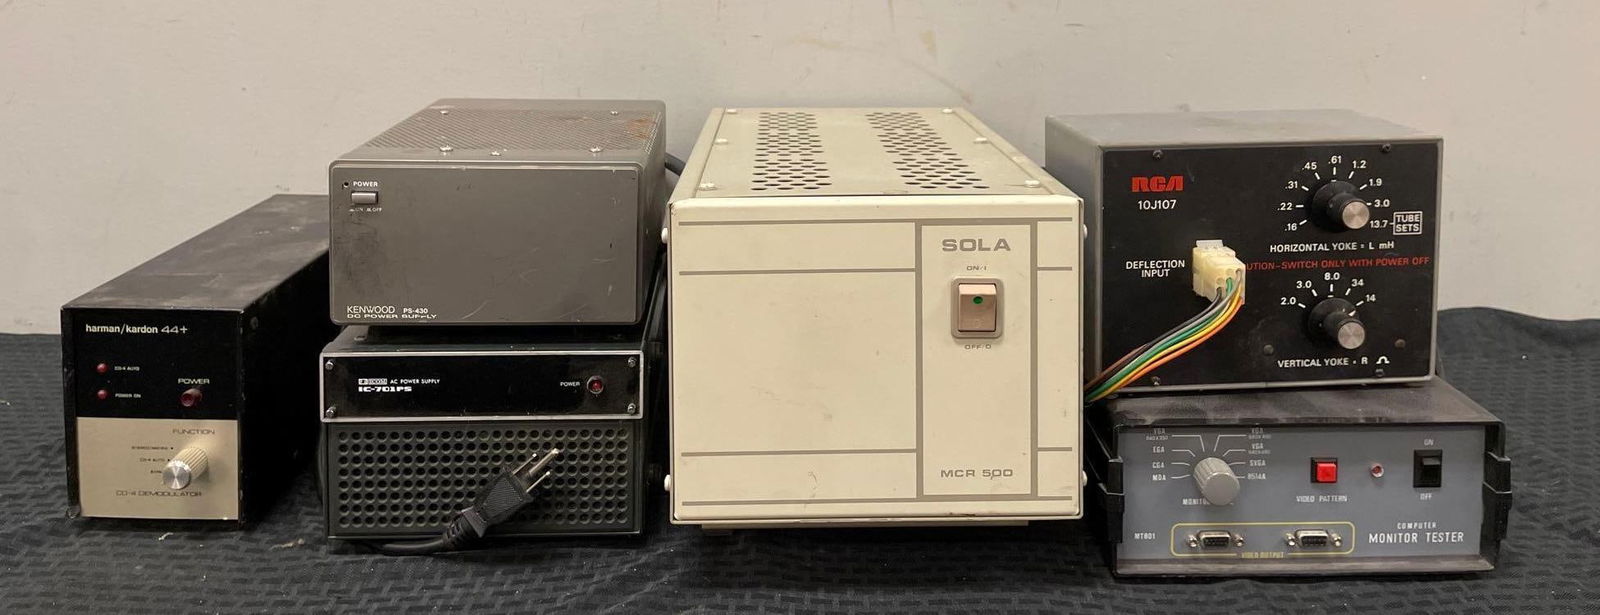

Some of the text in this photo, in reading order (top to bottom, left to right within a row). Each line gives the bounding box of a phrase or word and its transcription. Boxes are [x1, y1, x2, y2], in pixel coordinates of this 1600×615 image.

[1328, 155, 1342, 164] .61
[1302, 162, 1318, 171] .45
[1352, 160, 1367, 169] 1.2
[1131, 175, 1184, 193] RCA
[1285, 181, 1298, 189] .31
[1369, 178, 1382, 187] 1.9
[1137, 199, 1177, 211] 10J107
[1277, 203, 1293, 211] .22
[1374, 199, 1390, 208] 3.0
[1395, 214, 1420, 223] TUBE
[1284, 222, 1298, 231] .16
[1370, 219, 1388, 229] 13.7
[1395, 223, 1420, 232] SETS
[941, 238, 1012, 252] SOLA
[1270, 243, 1330, 253] HORIZONTAL
[1331, 242, 1358, 251] YOKE
[1368, 242, 1375, 250] L
[1379, 241, 1395, 250] mH
[1125, 259, 1186, 270] DEFLECTION
[1321, 259, 1345, 269] ONLY
[1349, 258, 1373, 267] WITH
[1375, 257, 1408, 267] POWER
[1412, 256, 1431, 265] OFF
[1141, 269, 1170, 278] INPUT
[1323, 272, 1340, 281] 8.0
[1296, 280, 1312, 289] 3.0
[1280, 297, 1297, 305] 2.0
[1365, 294, 1376, 302] 14
[346, 305, 396, 314] KENWOOD
[85, 324, 188, 335] harman/kardon 44+
[1277, 359, 1321, 368] VERTICAL
[1323, 358, 1349, 366] YOKE
[1361, 356, 1368, 365] R
[940, 469, 1013, 478] MCR 500
[1397, 521, 1437, 530] COMPUTER
[1368, 531, 1464, 544] MONITOR TESTER
[1241, 551, 1284, 559] VIDEO OUTPUT
